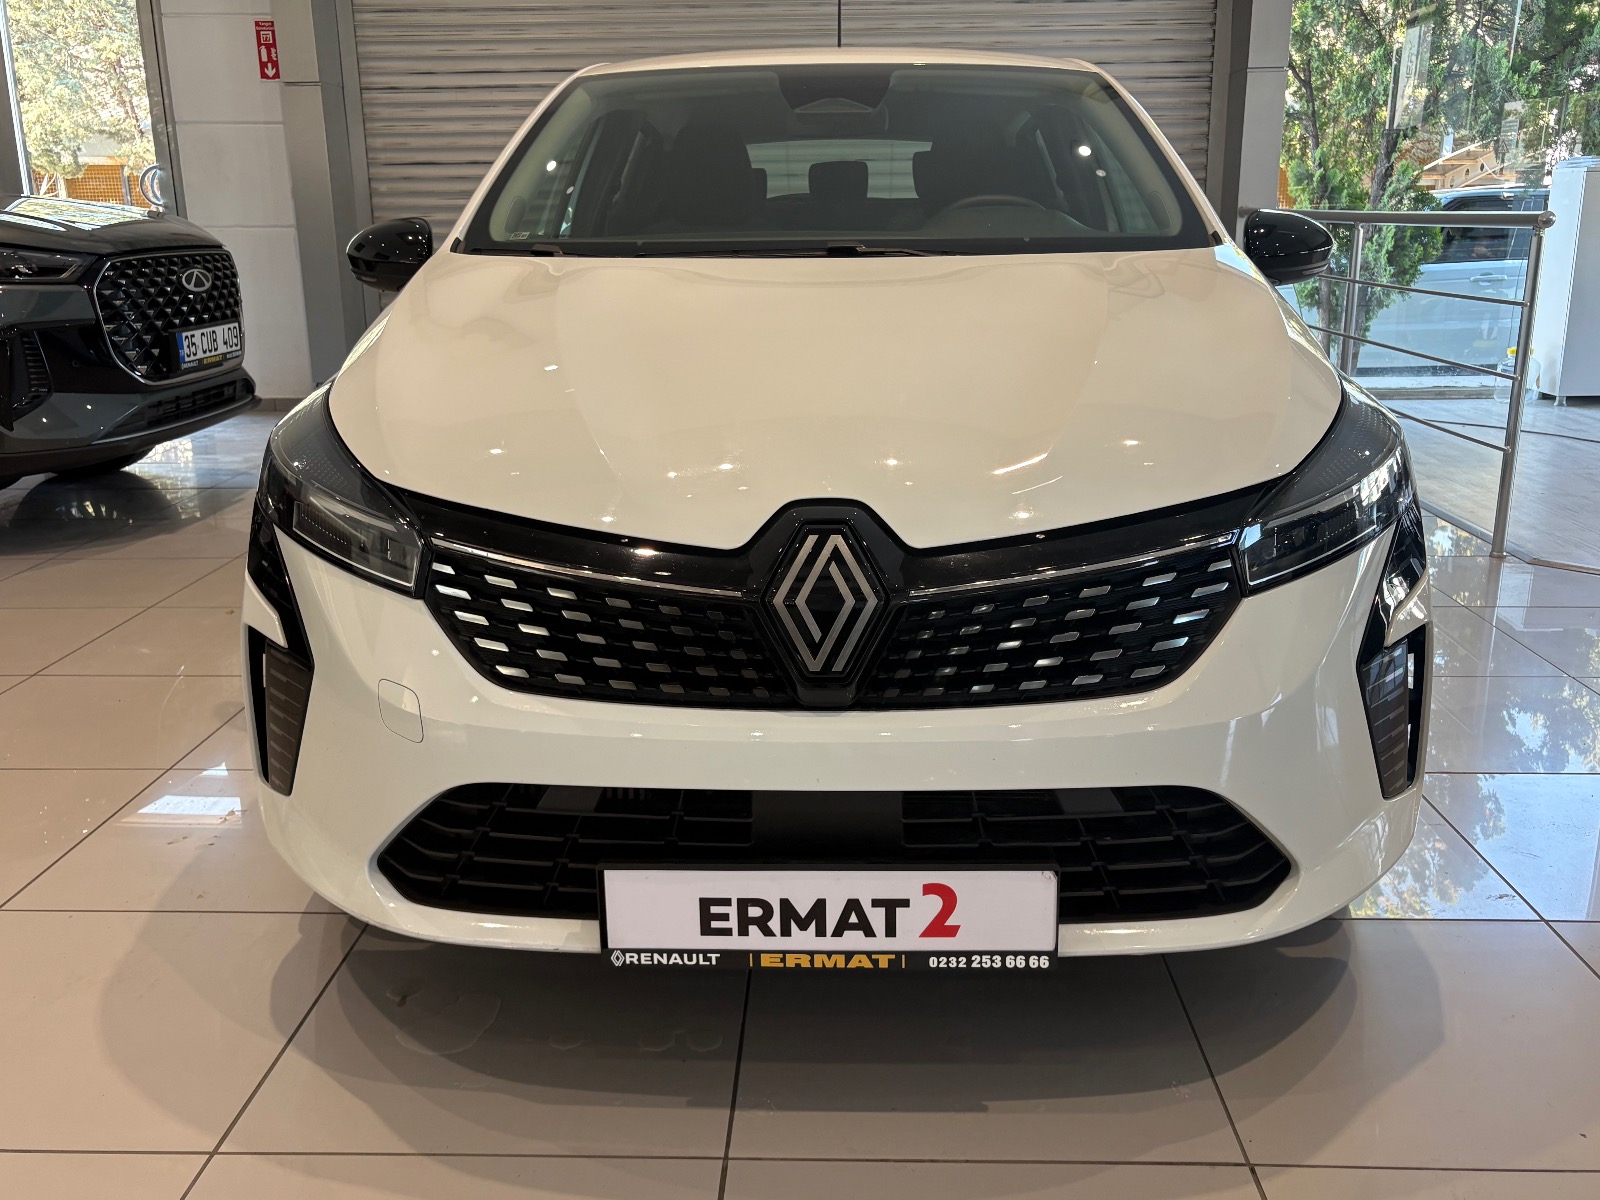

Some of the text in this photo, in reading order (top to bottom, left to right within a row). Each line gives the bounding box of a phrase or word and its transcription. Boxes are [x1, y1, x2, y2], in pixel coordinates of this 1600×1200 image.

[184, 326, 239, 358] 35 CUB 409
[699, 882, 961, 938] ERMAT 2
[625, 952, 1050, 969] RENAULT ERMAT 0232 253 66 66
